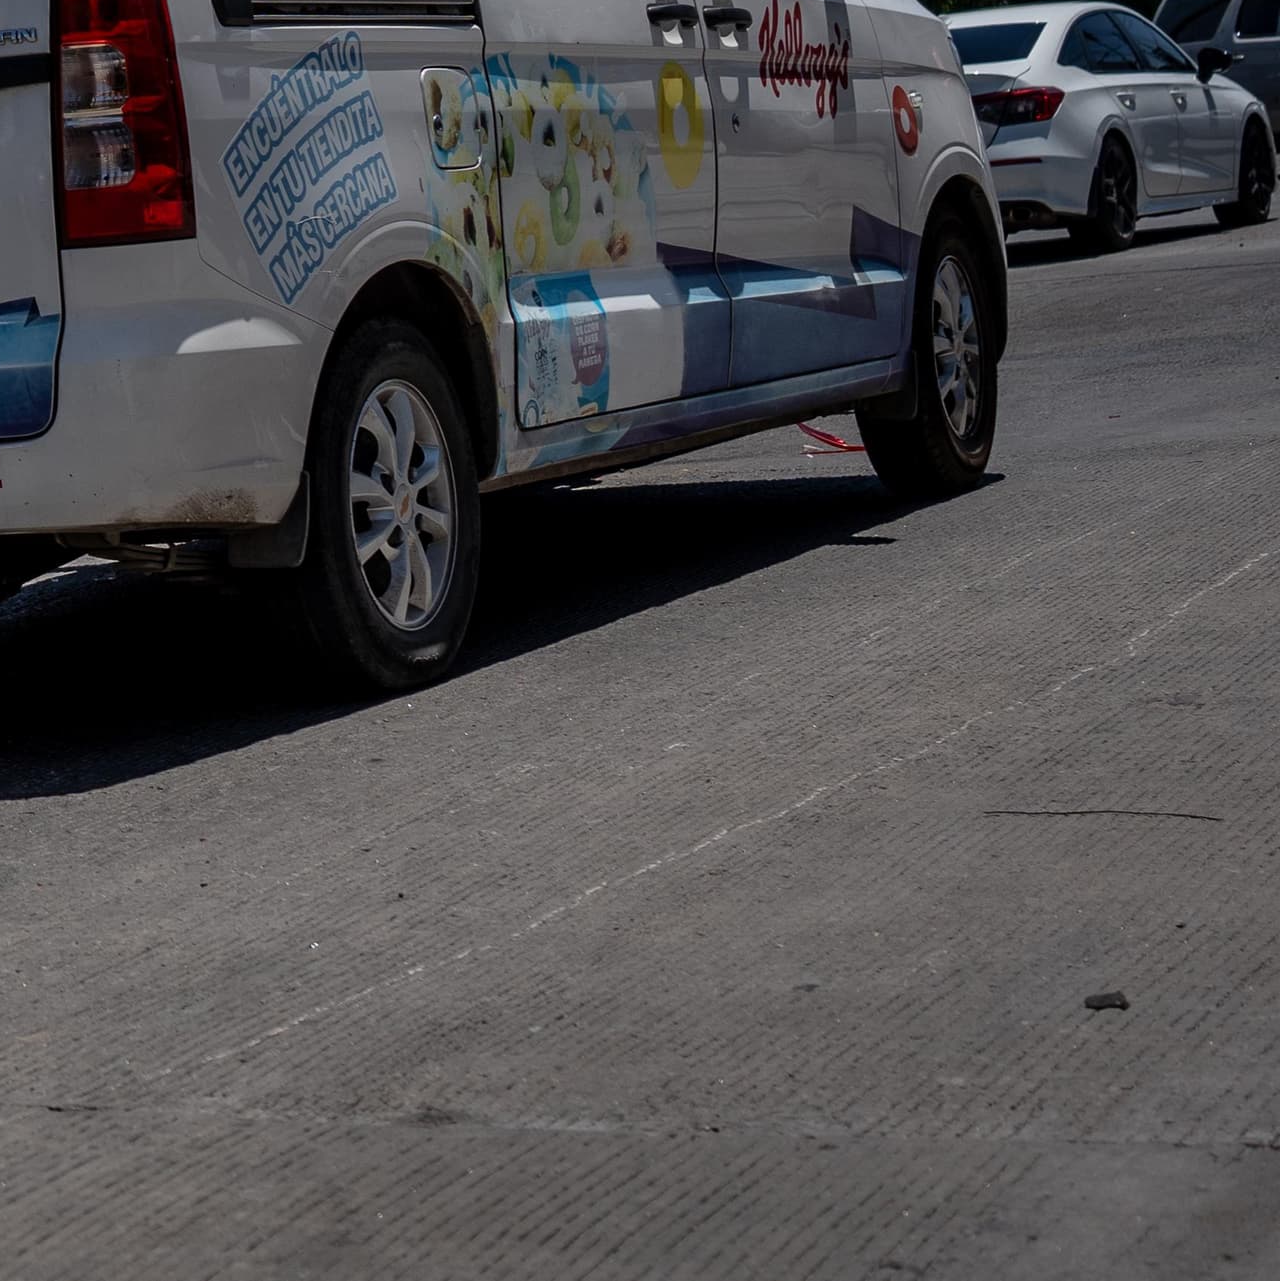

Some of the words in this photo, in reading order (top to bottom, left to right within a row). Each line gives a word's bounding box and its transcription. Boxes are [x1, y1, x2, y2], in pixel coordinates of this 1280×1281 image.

[225, 32, 362, 195] ENCUÉNTRALO
[244, 184, 281, 253] EN
[270, 150, 306, 215] TU
[296, 92, 383, 184] TIENDITA
[269, 220, 323, 303] MÁS
[314, 153, 396, 248] CERCANA
